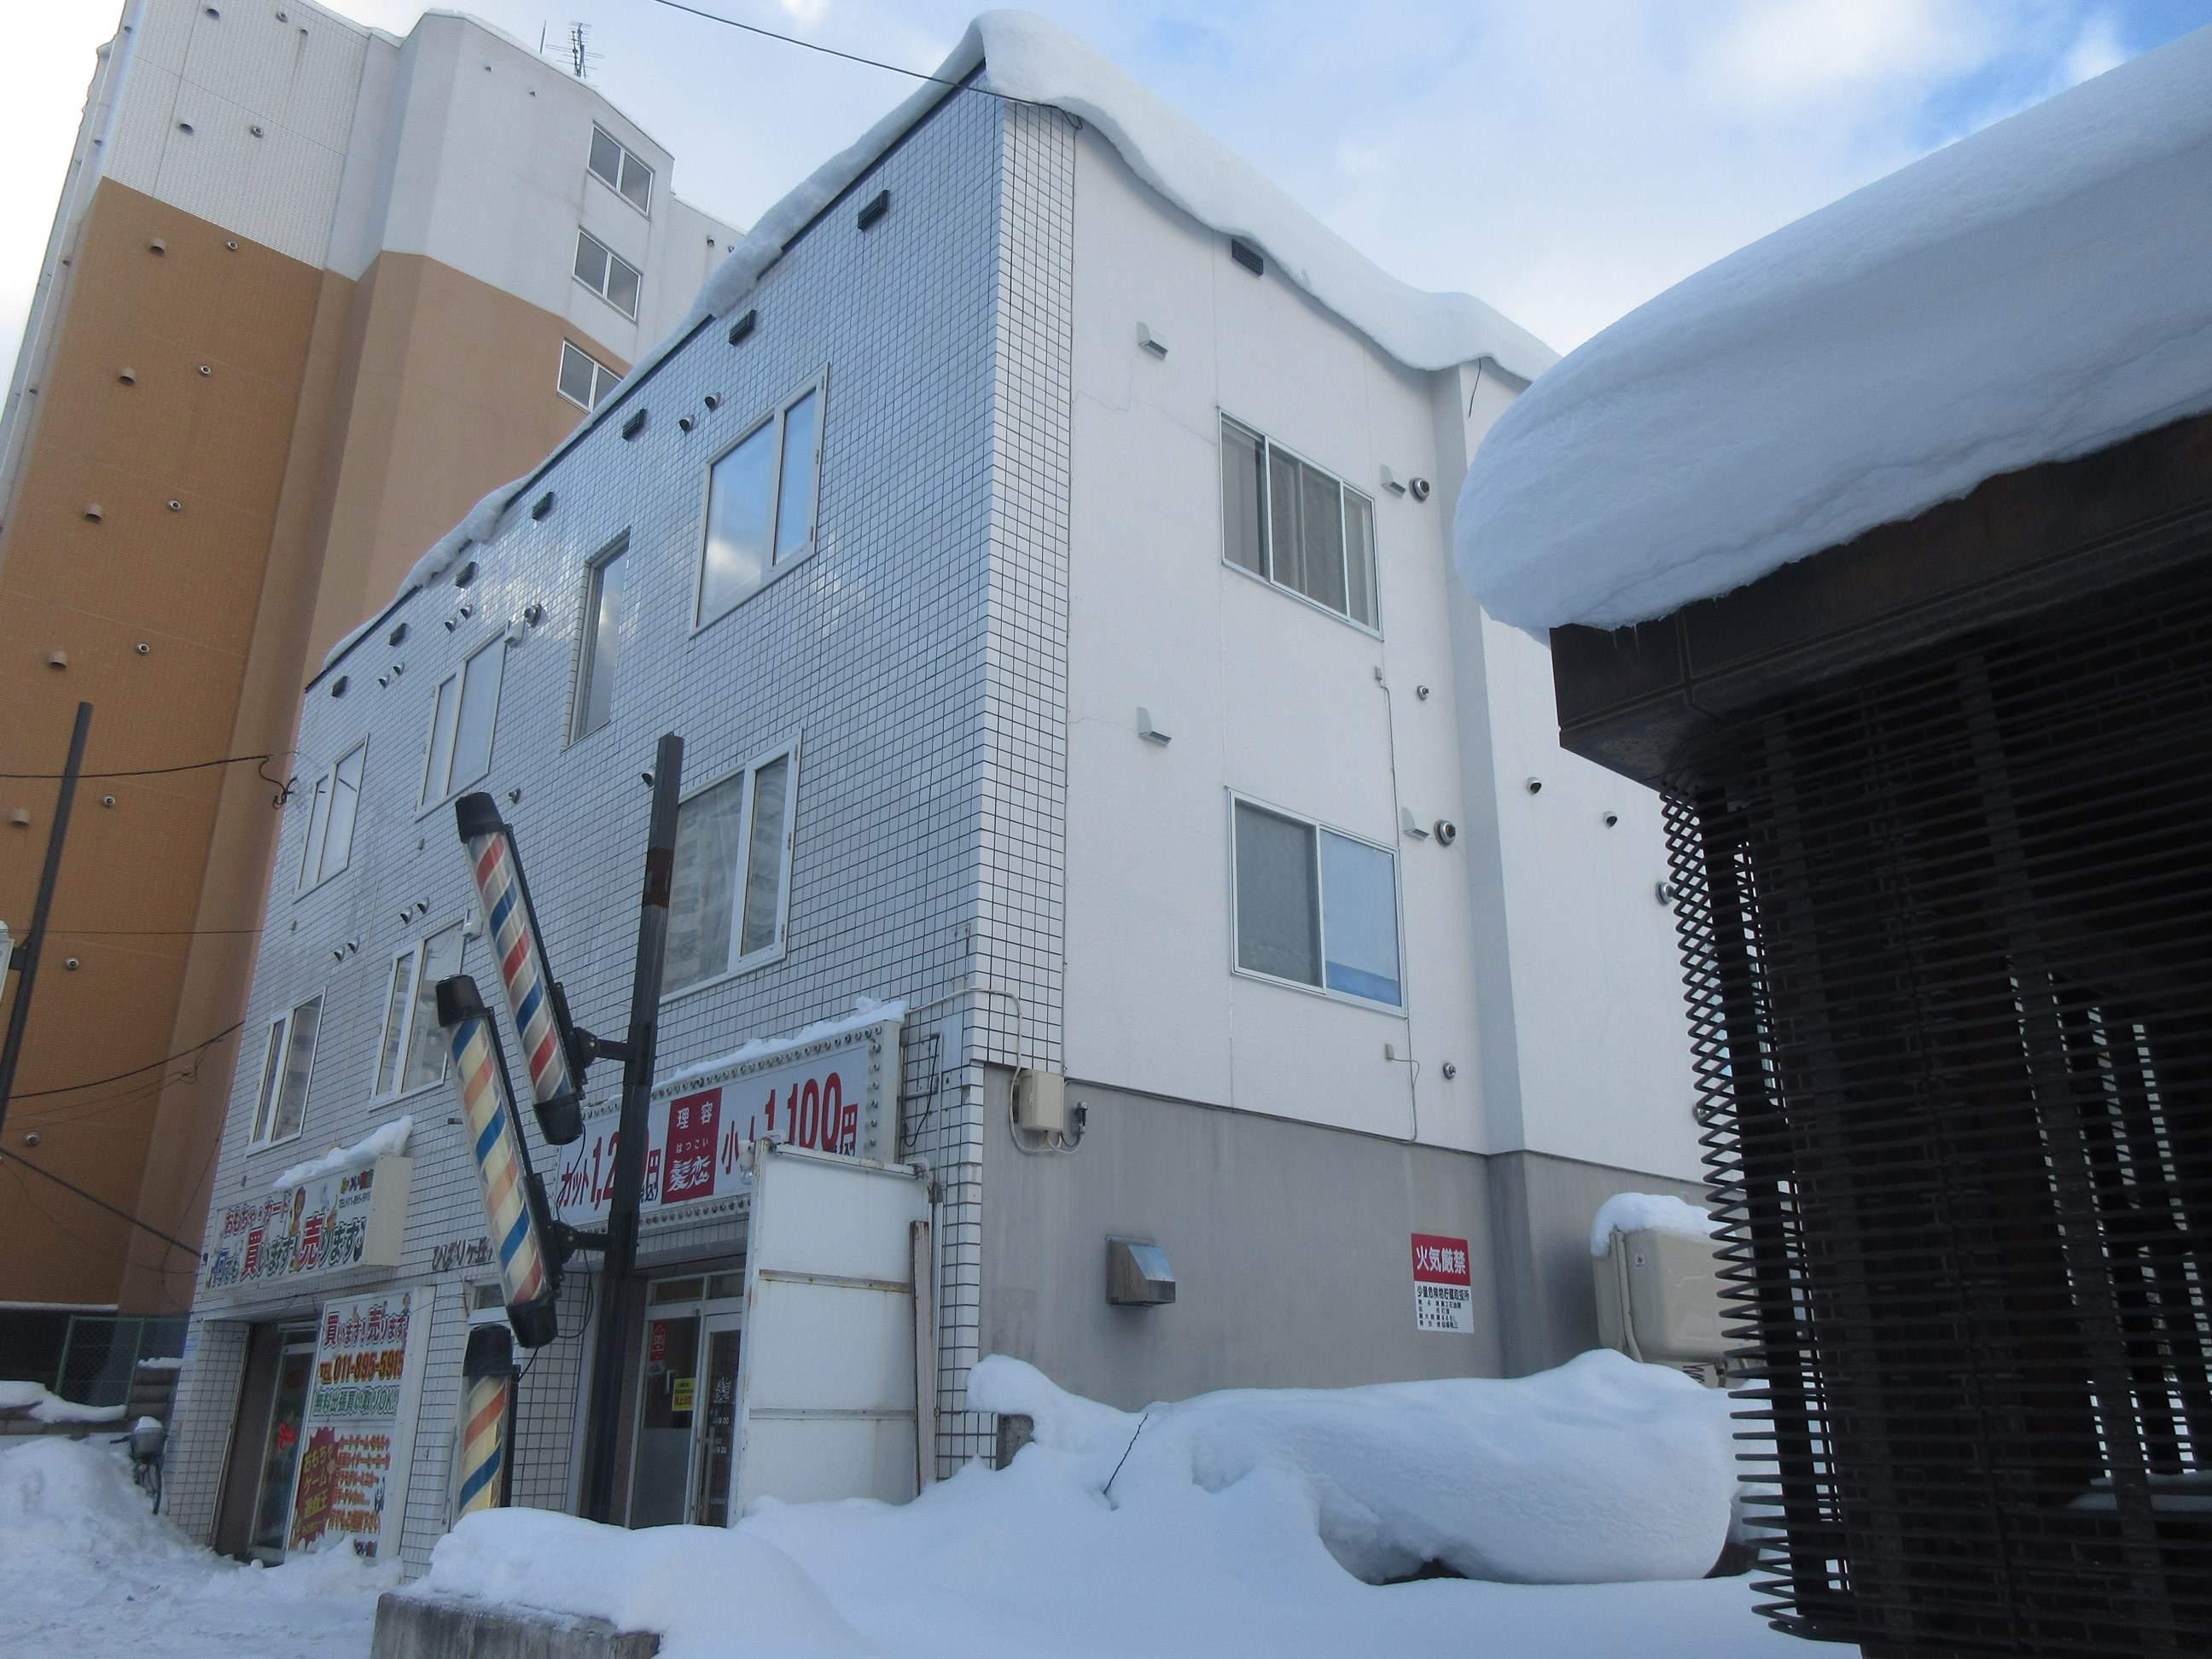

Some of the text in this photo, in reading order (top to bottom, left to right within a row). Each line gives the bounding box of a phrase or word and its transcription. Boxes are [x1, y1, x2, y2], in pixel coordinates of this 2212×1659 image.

[677, 1099, 714, 1131] 理容
[1416, 1245, 1466, 1274] 火気厳禁
